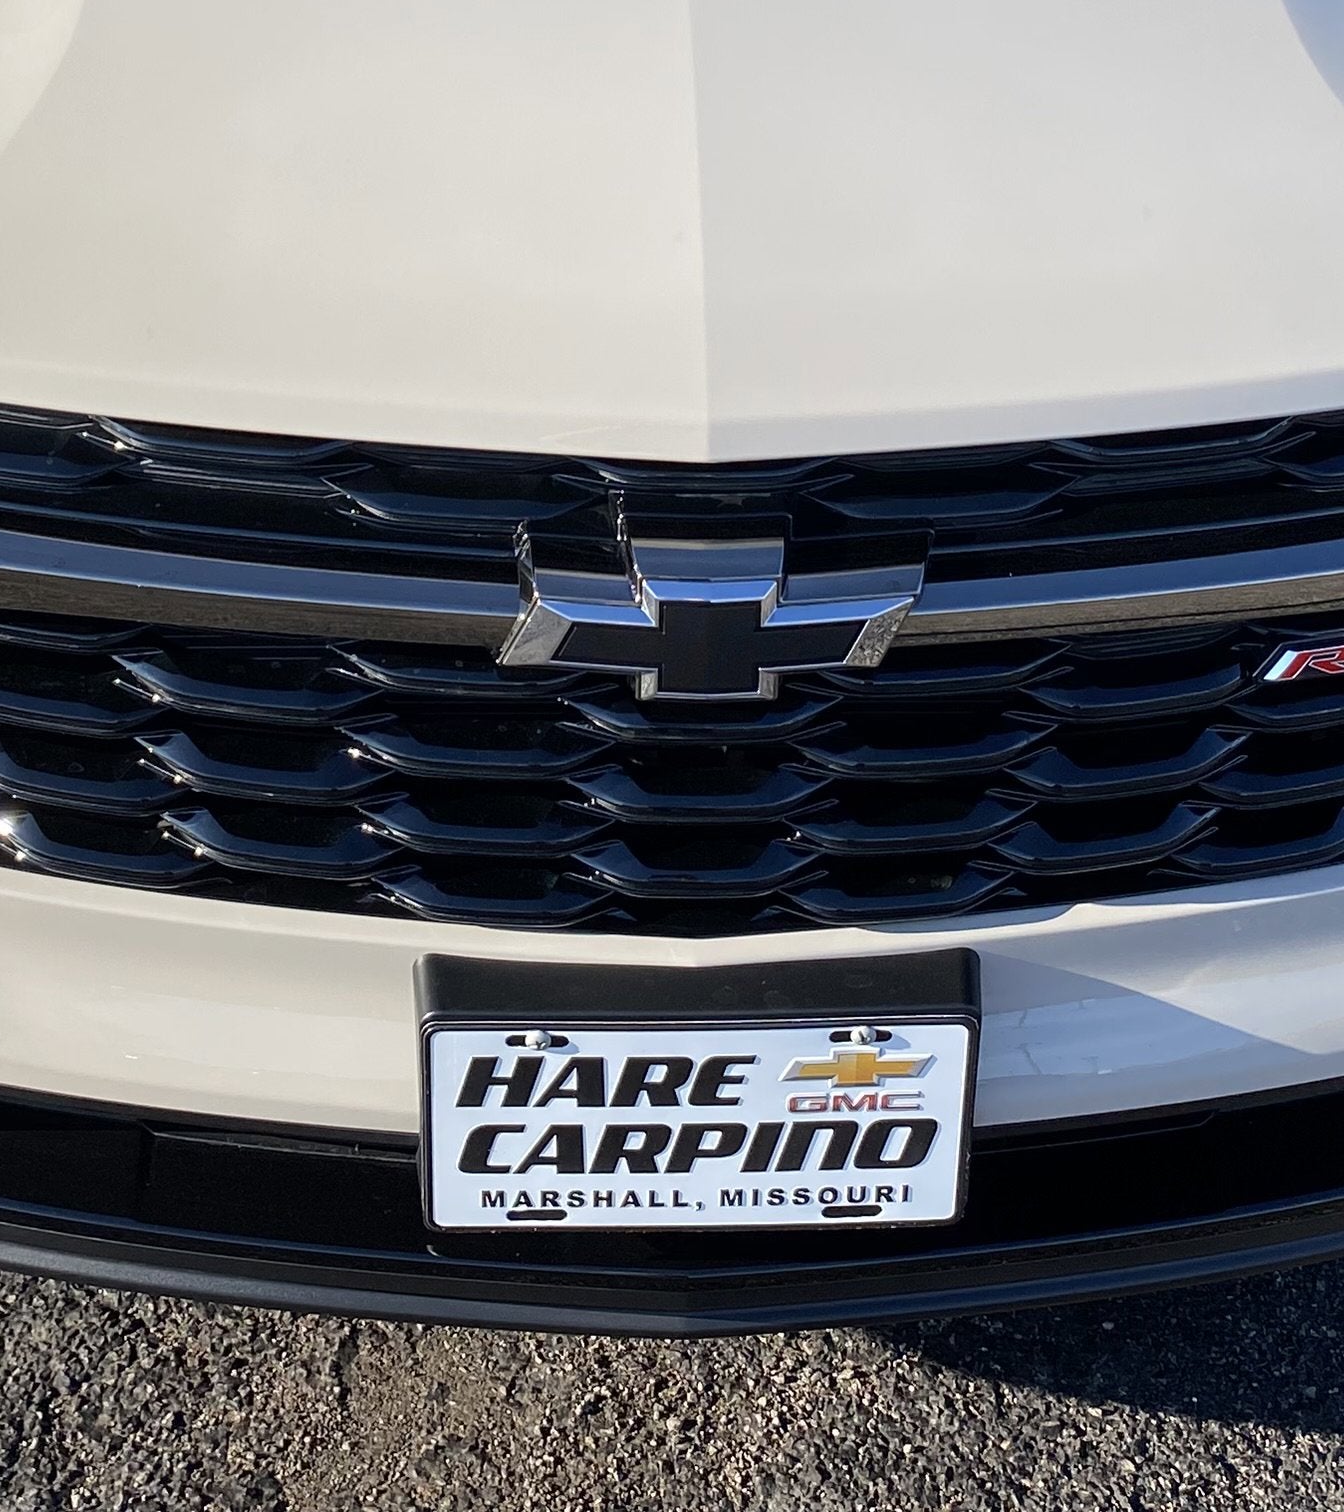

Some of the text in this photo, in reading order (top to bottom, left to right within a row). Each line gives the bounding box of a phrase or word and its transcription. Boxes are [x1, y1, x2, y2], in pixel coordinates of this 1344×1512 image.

[455, 1054, 760, 1108] HARE
[785, 1090, 924, 1113] GMC
[456, 1117, 940, 1175] CARPINO
[480, 1183, 912, 1211] MARSHALL, MISSOURI
